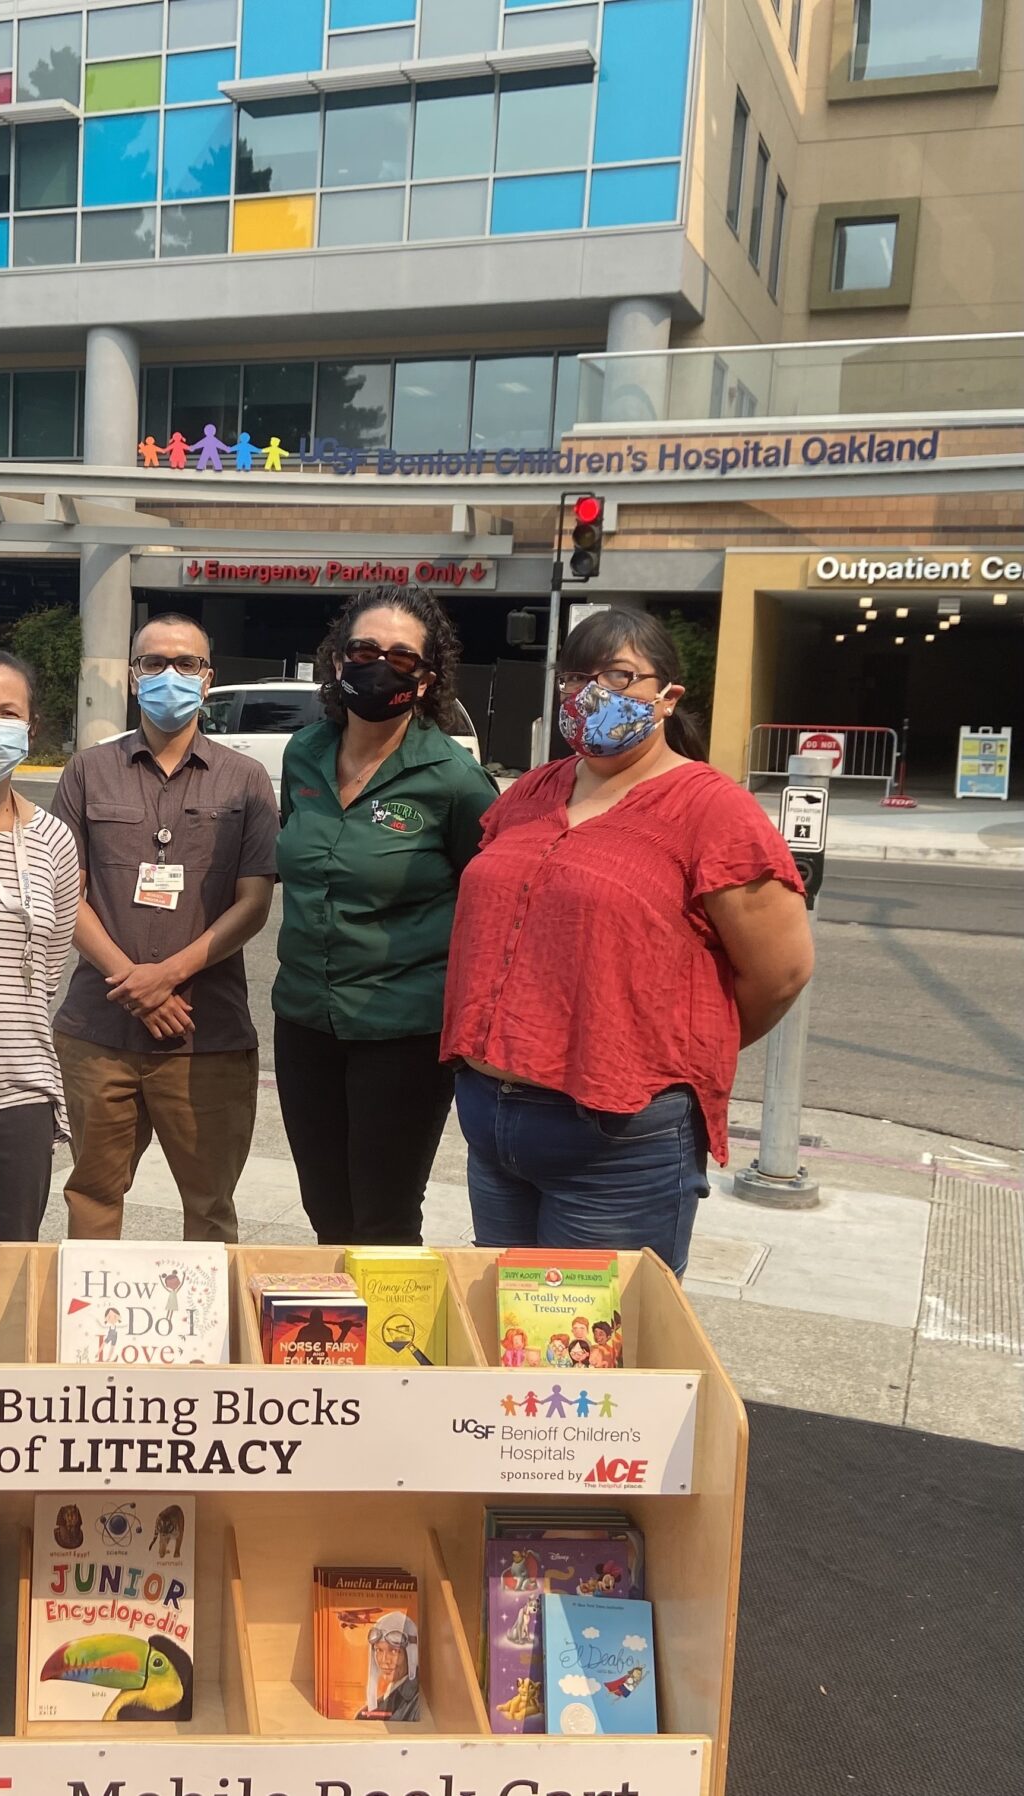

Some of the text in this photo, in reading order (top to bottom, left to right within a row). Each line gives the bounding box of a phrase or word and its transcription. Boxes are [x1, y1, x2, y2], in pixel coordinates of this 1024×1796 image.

[377, 447, 487, 475] Benioff
[494, 445, 647, 476] Children's
[658, 438, 792, 475] Hospital
[801, 430, 940, 466] Oakland
[204, 560, 468, 586] Emergency Parking Only
[816, 556, 1024, 584] Outpatient Ce
[387, 691, 413, 705] ACE
[81, 1270, 159, 1299] How
[367, 1279, 432, 1294] Nancy Drew
[514, 1293, 596, 1305] A Totally Moody
[534, 1304, 577, 1315] Treasury
[125, 1306, 198, 1337] Do I
[95, 1334, 175, 1364] Love
[279, 1342, 359, 1352] NORSE FAIRY
[283, 1357, 354, 1365] FOLK TALES
[212, 1387, 361, 1426] Blocks
[452, 1418, 641, 1442] UCSF Benioff Children's
[59, 1438, 302, 1475] LITERACY
[500, 1445, 575, 1463] Hospitals
[500, 1454, 648, 1483] sponsored by ACE
[548, 1551, 569, 1562] Disney
[50, 1562, 186, 1610] JUNIOR
[336, 1577, 414, 1590] Amelia Earhart
[46, 1599, 189, 1641] Encyclopedia
[584, 1644, 634, 1673] Deafo
